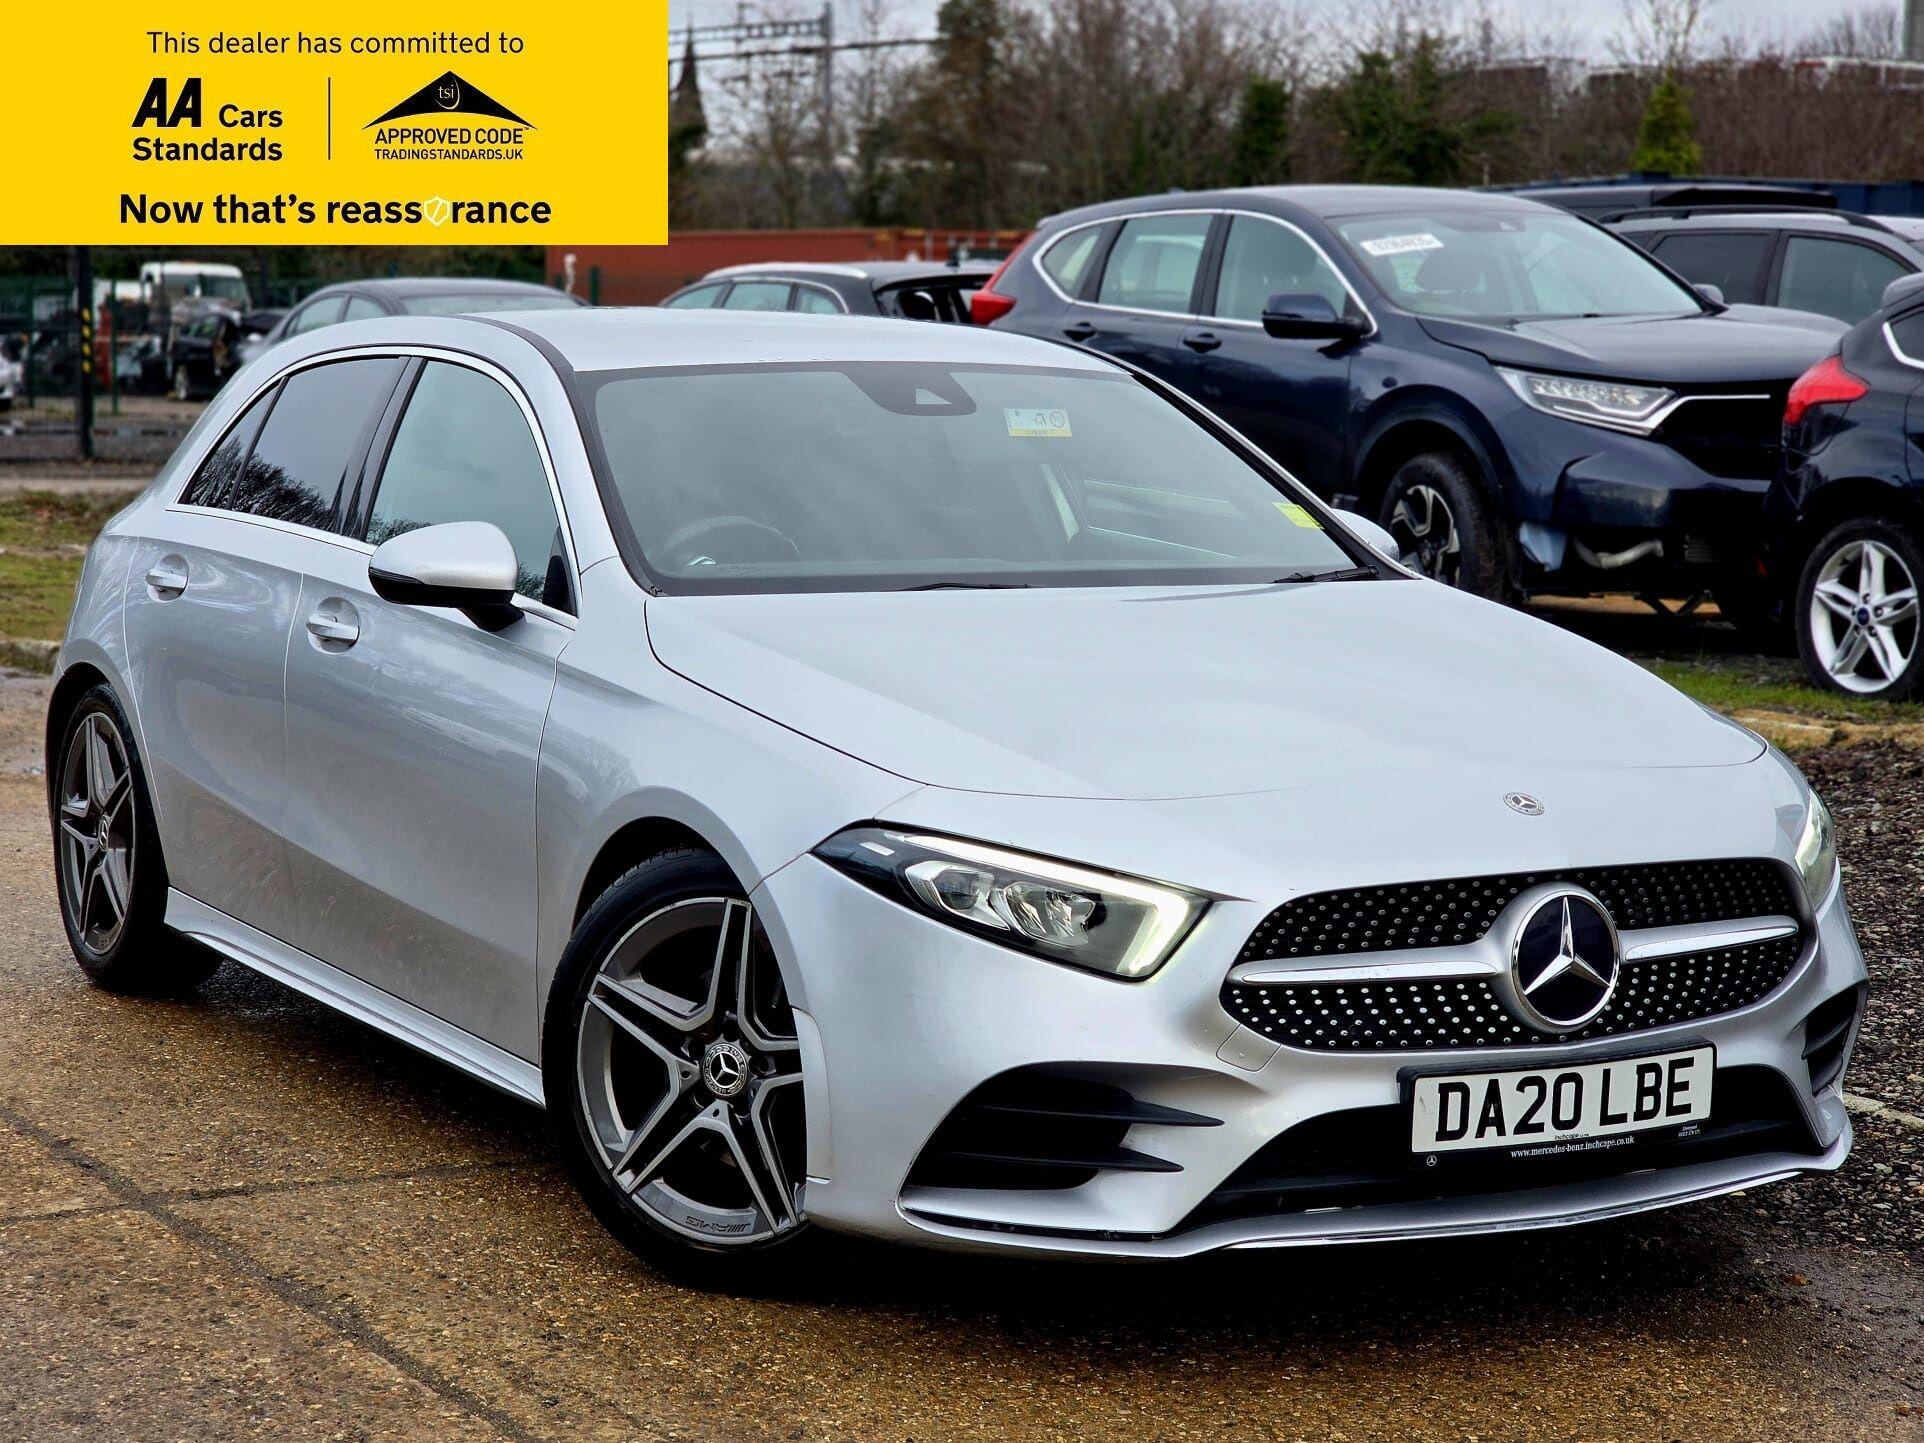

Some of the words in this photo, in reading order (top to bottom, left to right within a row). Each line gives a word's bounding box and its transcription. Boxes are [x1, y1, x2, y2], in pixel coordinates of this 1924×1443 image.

[1435, 1072, 1584, 1142] DA20
[1599, 1056, 1695, 1127] LBE
[1511, 1136, 1635, 1159] www.mercedes-benz.inchcape.co.uk
